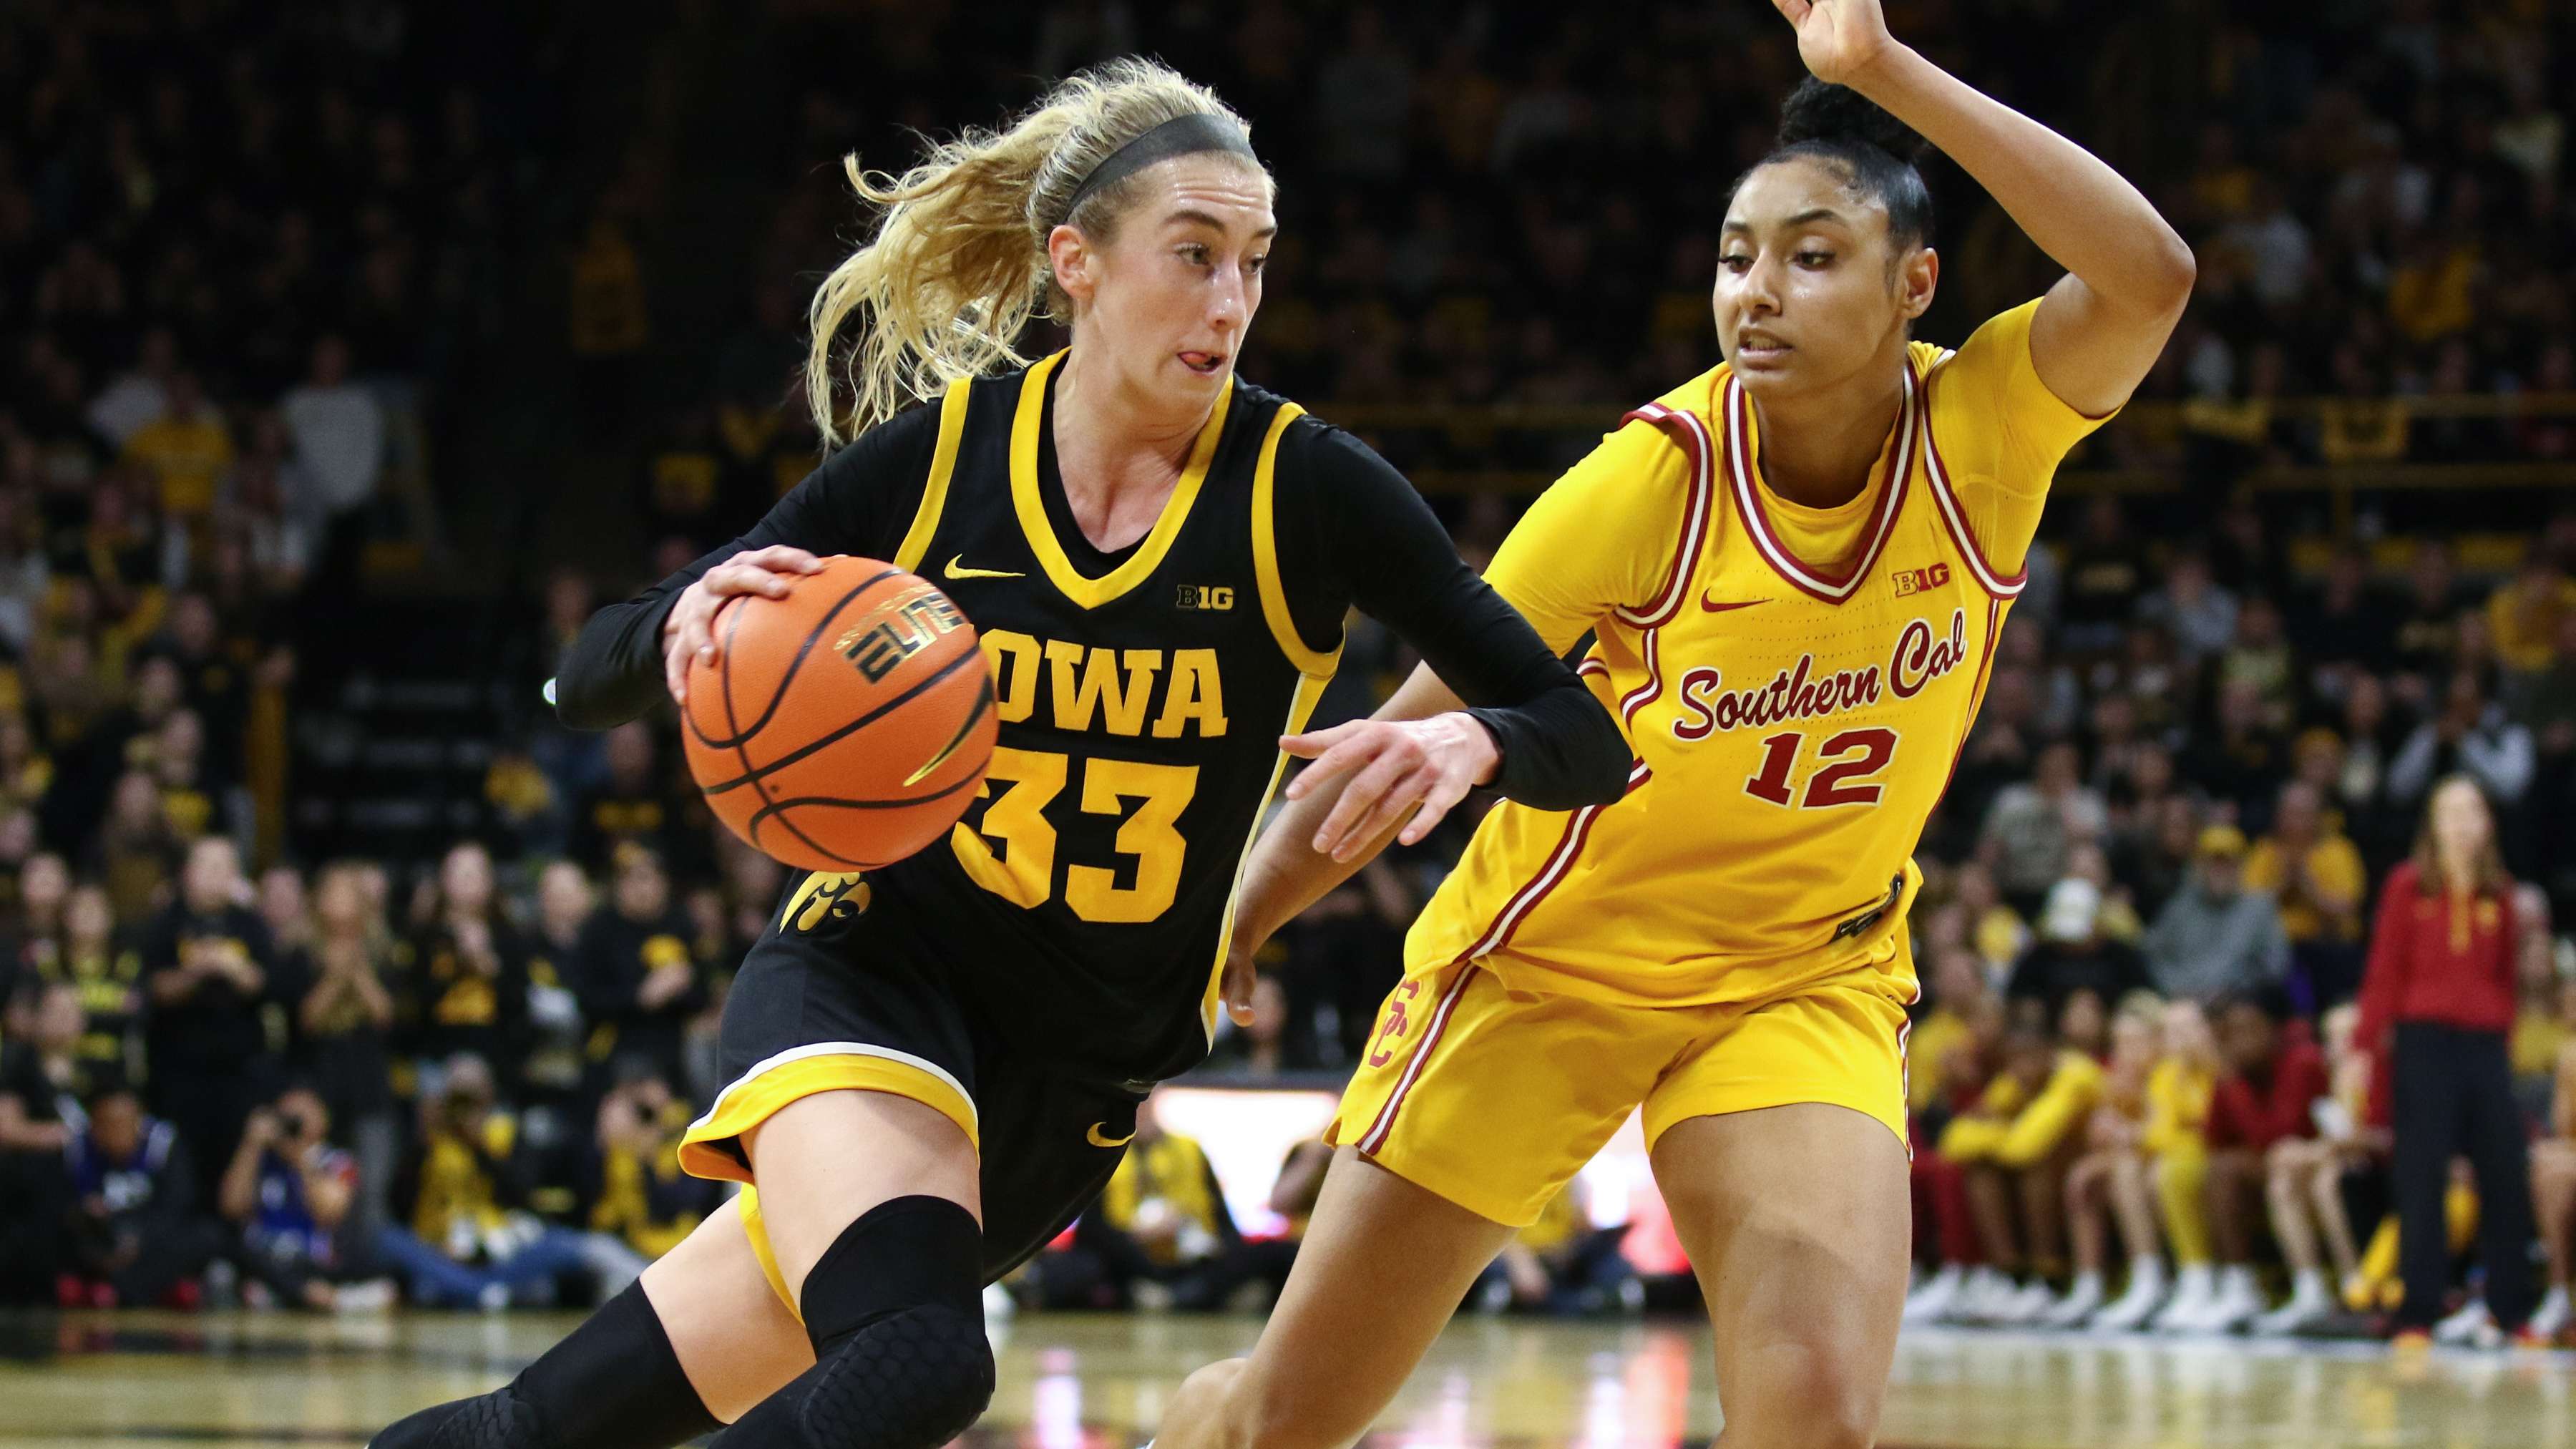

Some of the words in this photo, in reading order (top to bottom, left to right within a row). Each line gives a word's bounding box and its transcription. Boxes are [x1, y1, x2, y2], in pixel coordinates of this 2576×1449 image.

[842, 591, 963, 685] ELITE
[978, 628, 1228, 738] OWA
[1672, 653, 1881, 740] Southern
[1890, 607, 1966, 698] Cal
[1742, 726, 1900, 810] 12
[951, 746, 1199, 923] 33
